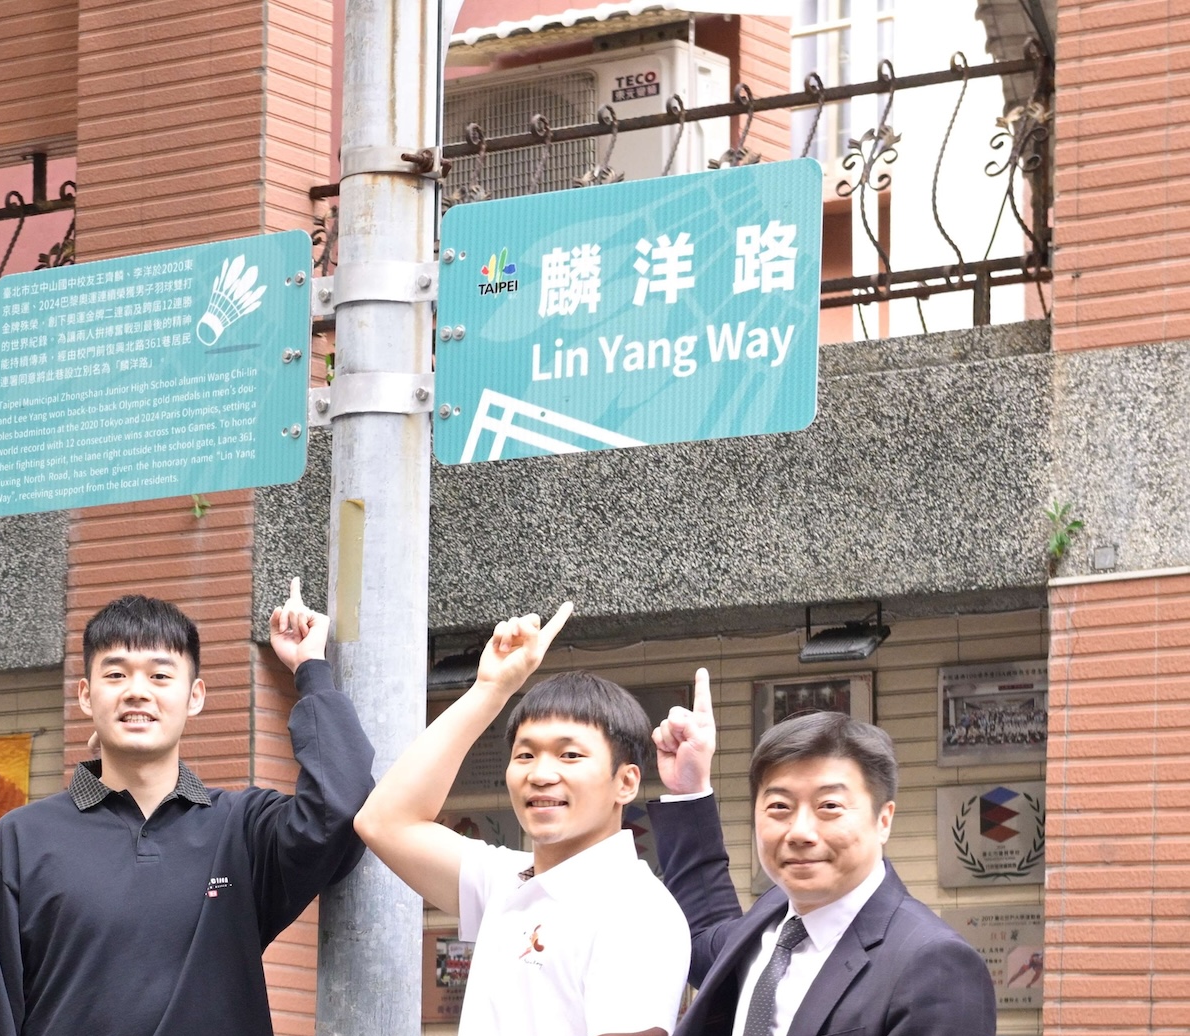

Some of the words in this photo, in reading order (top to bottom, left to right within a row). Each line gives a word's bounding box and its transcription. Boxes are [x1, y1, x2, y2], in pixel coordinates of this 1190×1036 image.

[615, 71, 656, 88] TECO
[478, 280, 518, 296] TAIPEI
[538, 220, 798, 319] 麟洋路
[532, 338, 588, 382] Lin
[598, 333, 698, 377] Yang
[706, 321, 795, 368] Way
[14, 413, 28, 422] Lee
[28, 410, 48, 423] Yang
[48, 410, 65, 418] won
[67, 401, 117, 416] back-to-back
[118, 397, 151, 411] Olympic
[152, 394, 171, 406] gold
[172, 390, 201, 402] medals
[202, 389, 210, 398] in
[238, 382, 257, 393] dou-
[22, 394, 59, 408] Municipal
[60, 388, 103, 403] Zhongshan
[104, 384, 129, 395] Junior
[131, 382, 149, 394] High
[150, 378, 177, 389] School
[178, 374, 206, 386] alumni
[207, 371, 230, 384] Wang
[231, 367, 257, 378] Chi-lin
[14, 425, 56, 438] badminton
[56, 424, 65, 433] at
[66, 422, 79, 431] the
[80, 420, 99, 430] 2020
[100, 416, 124, 429] Tokyo
[124, 414, 140, 424] and
[141, 412, 160, 422] 2024
[161, 409, 181, 419] Paris
[222, 400, 250, 414] setting
[20, 442, 45, 453] record
[47, 440, 64, 450] with
[66, 438, 75, 447] 12
[76, 433, 123, 446] consecutive
[124, 430, 143, 440] wins
[144, 429, 169, 438] across
[171, 425, 187, 434] two
[220, 419, 230, 428] To
[232, 416, 257, 427] honor
[16, 457, 45, 471] fighting
[70, 453, 83, 462] the
[84, 450, 102, 460] lane
[102, 448, 121, 460] right
[122, 444, 152, 456] outside
[154, 442, 167, 452] the
[168, 439, 195, 450] school
[218, 434, 238, 444] Lane
[24, 473, 45, 483] North
[73, 468, 87, 477] has
[90, 465, 109, 476] been
[112, 463, 133, 475] given
[136, 461, 149, 470] the
[152, 456, 188, 470] honorary
[190, 455, 214, 464] name
[235, 448, 256, 461] Yang
[18, 488, 54, 502] receiving
[54, 485, 84, 498] support
[86, 482, 105, 492] from
[106, 480, 119, 490] the
[120, 478, 139, 488] local
